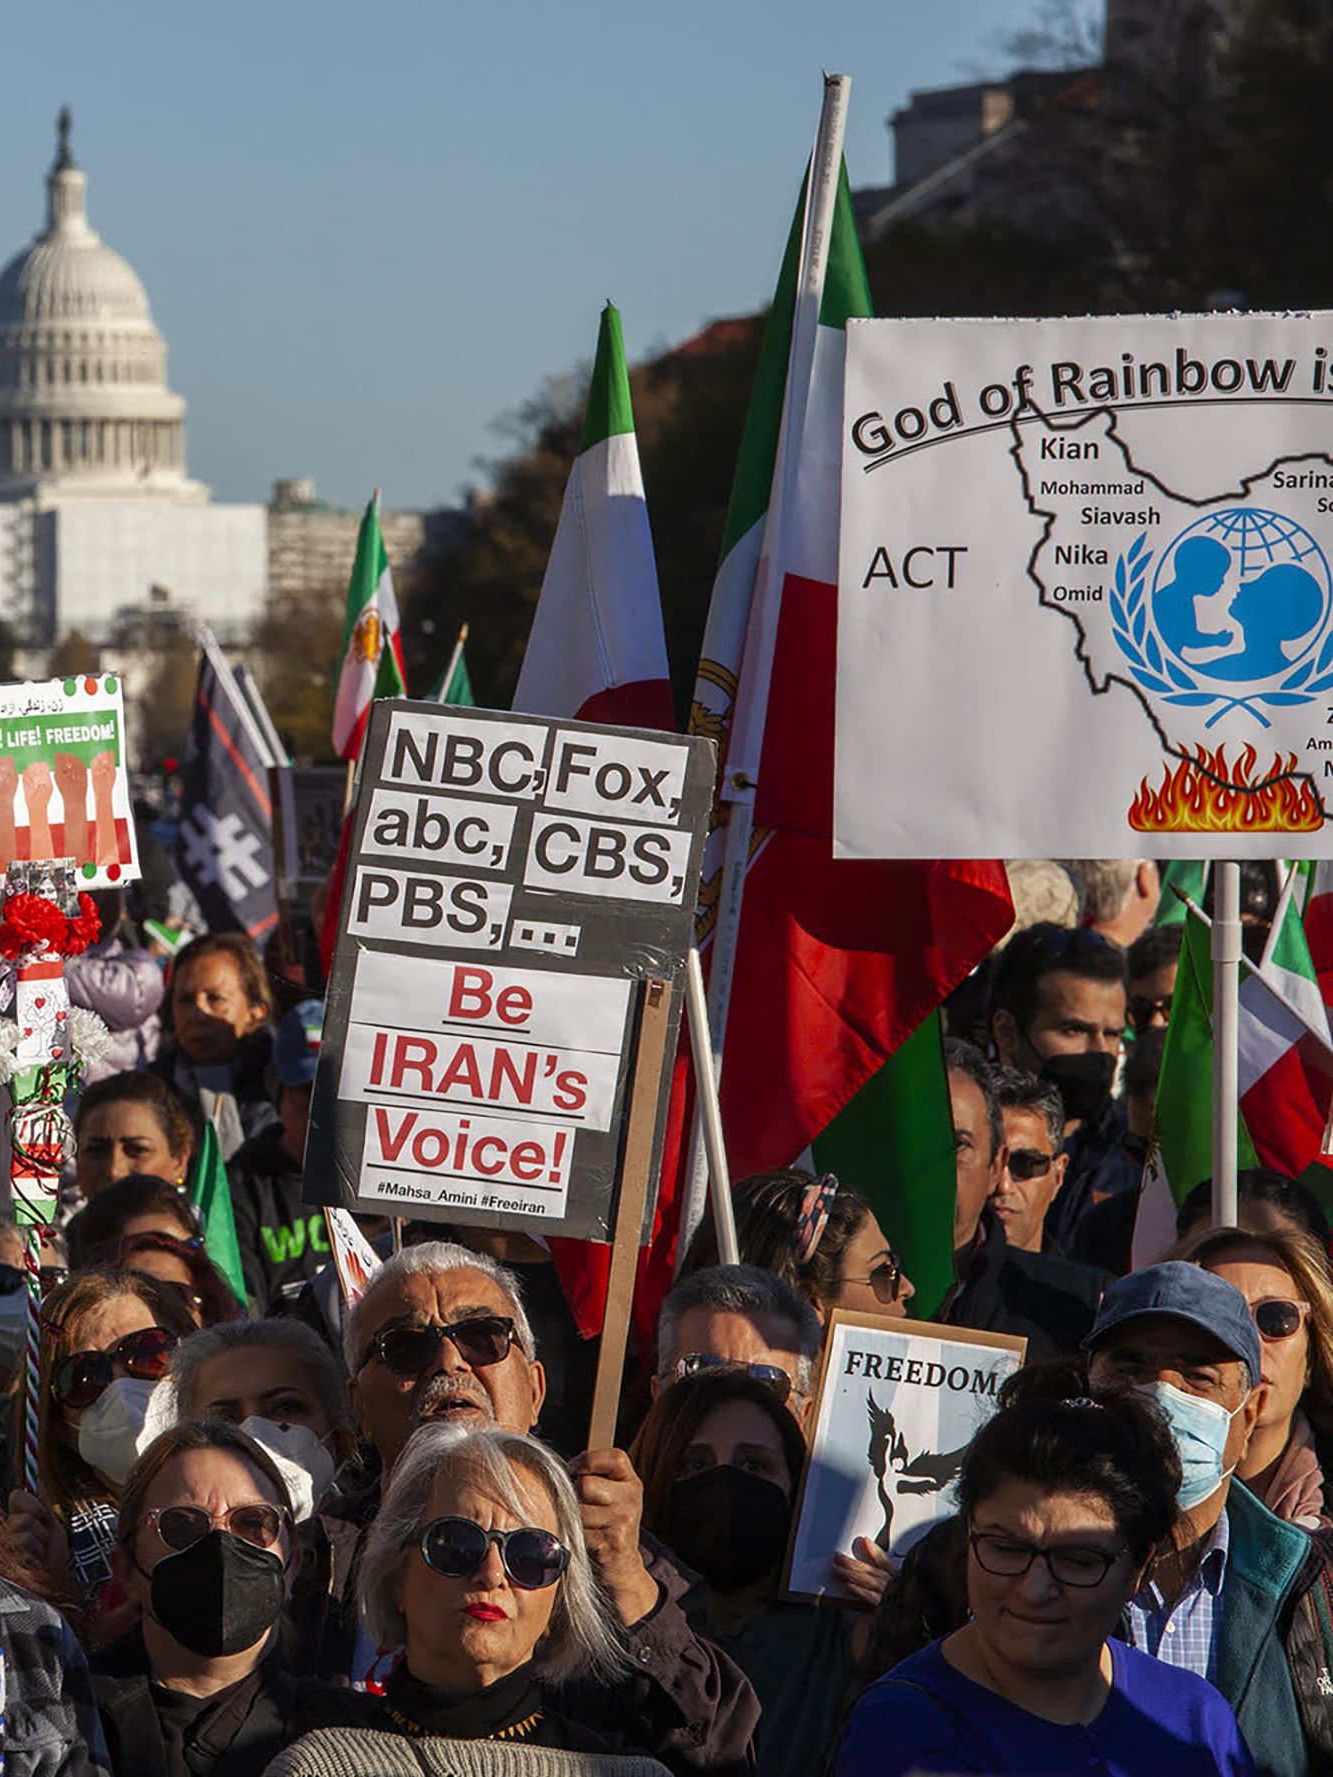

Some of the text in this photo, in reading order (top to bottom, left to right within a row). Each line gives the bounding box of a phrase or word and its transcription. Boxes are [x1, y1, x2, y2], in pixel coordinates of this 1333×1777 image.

[852, 381, 964, 457] God
[979, 365, 1034, 417] of
[1050, 348, 1296, 406] Rainbow
[1041, 437, 1099, 459] Kian
[1041, 480, 1144, 494] Mohammad
[1081, 507, 1160, 524] Siavash
[862, 546, 968, 588] ACT
[1055, 544, 1107, 564] Nika
[1053, 586, 1103, 601] Omid
[7, 725, 42, 748] LIFE!
[46, 720, 115, 745] FREEDOM!
[391, 728, 682, 819] NBC, Fox,
[373, 799, 684, 898] abc, CBS,
[356, 873, 503, 946] PBS,
[448, 965, 533, 1025] Be
[369, 1032, 588, 1111] IRAN’s
[375, 1108, 566, 1184] Voice!
[377, 1181, 478, 1206] #Mahsa_Amini
[844, 1350, 999, 1397] FREEDOM
